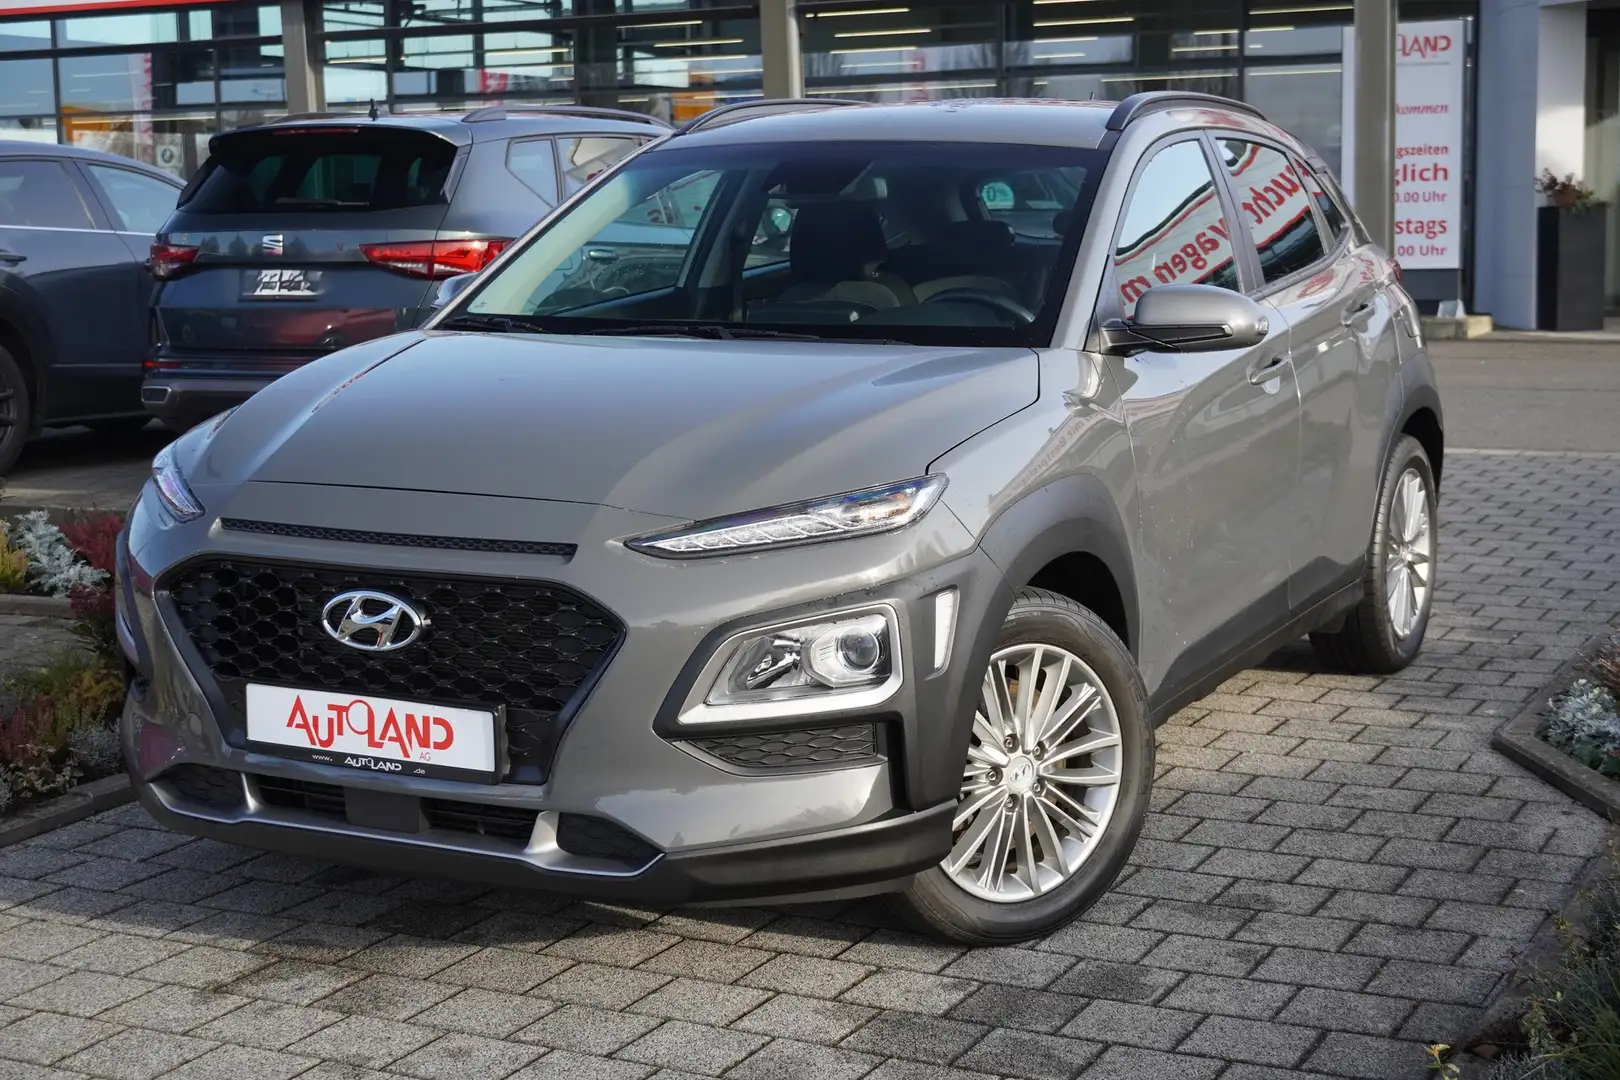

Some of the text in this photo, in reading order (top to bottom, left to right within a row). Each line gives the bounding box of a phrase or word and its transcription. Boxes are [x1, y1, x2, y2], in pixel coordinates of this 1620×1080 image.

[1395, 144, 1448, 159] gszeiten
[1422, 191, 1447, 202] Uhr
[1394, 218, 1447, 239] stags
[1419, 245, 1446, 256] Uhr
[286, 694, 454, 758] AUTOLAND
[311, 753, 333, 762] www.
[344, 756, 403, 772] AUTOLAND
[418, 751, 432, 762] AG
